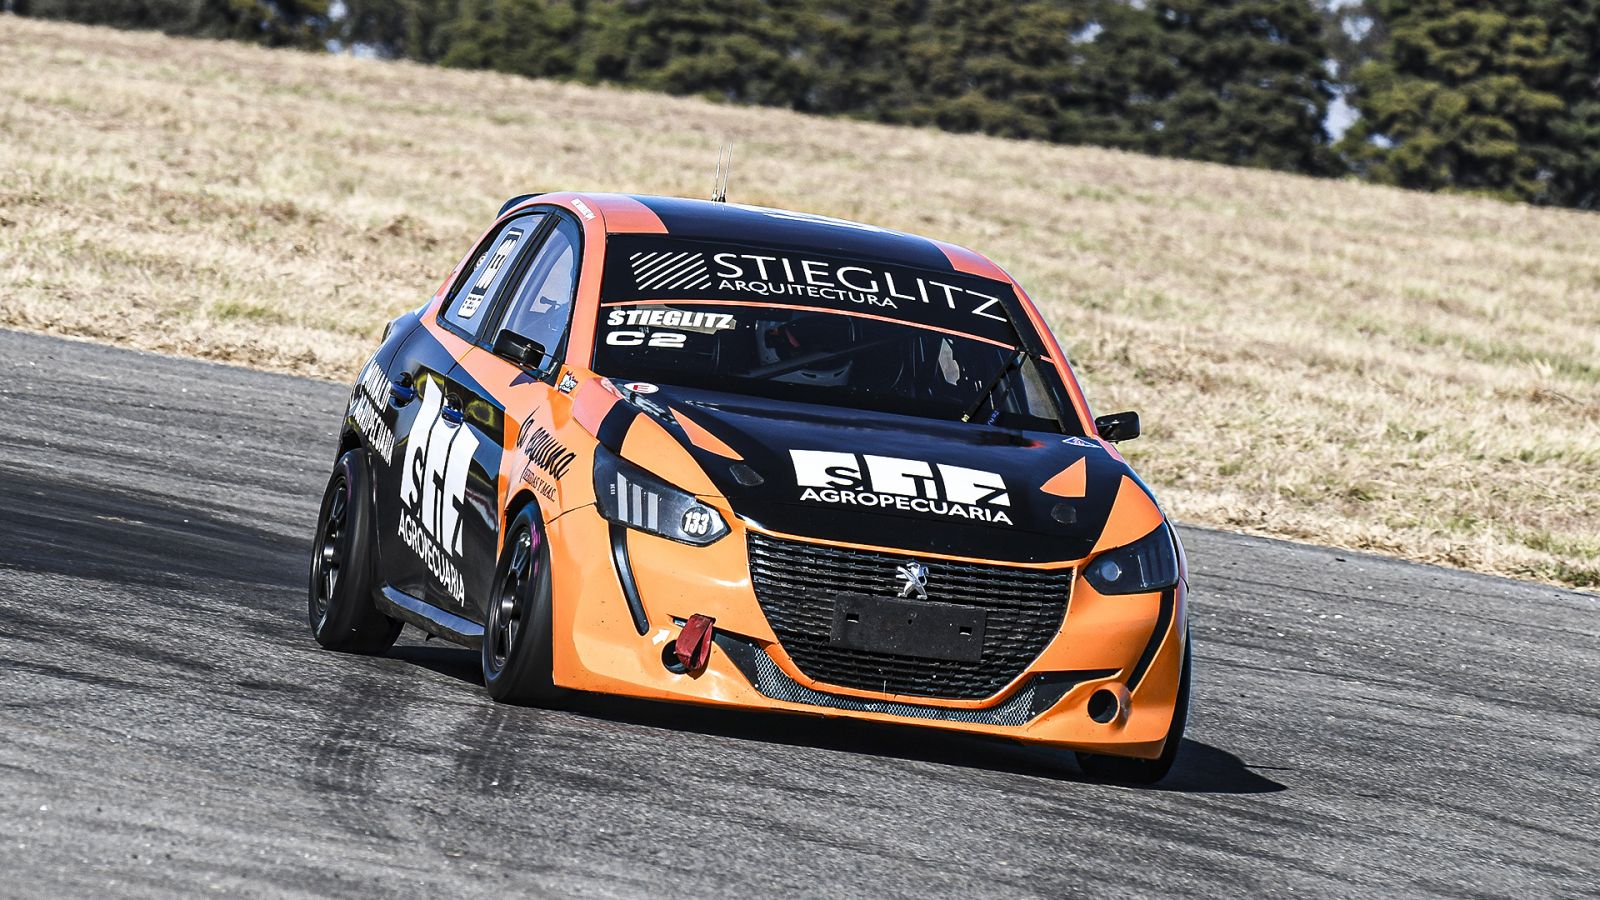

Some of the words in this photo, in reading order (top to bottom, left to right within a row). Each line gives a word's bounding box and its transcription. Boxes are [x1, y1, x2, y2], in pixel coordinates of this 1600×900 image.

[713, 252, 1007, 322] STIEGLITZ
[718, 280, 899, 309] ARQUITECTURA
[606, 310, 735, 330] STIEGLITZ
[606, 331, 687, 348] C2
[800, 488, 1013, 525] AGROPECUARIA
[683, 511, 709, 534] 133
[398, 507, 465, 607] AGROPECUARIA
